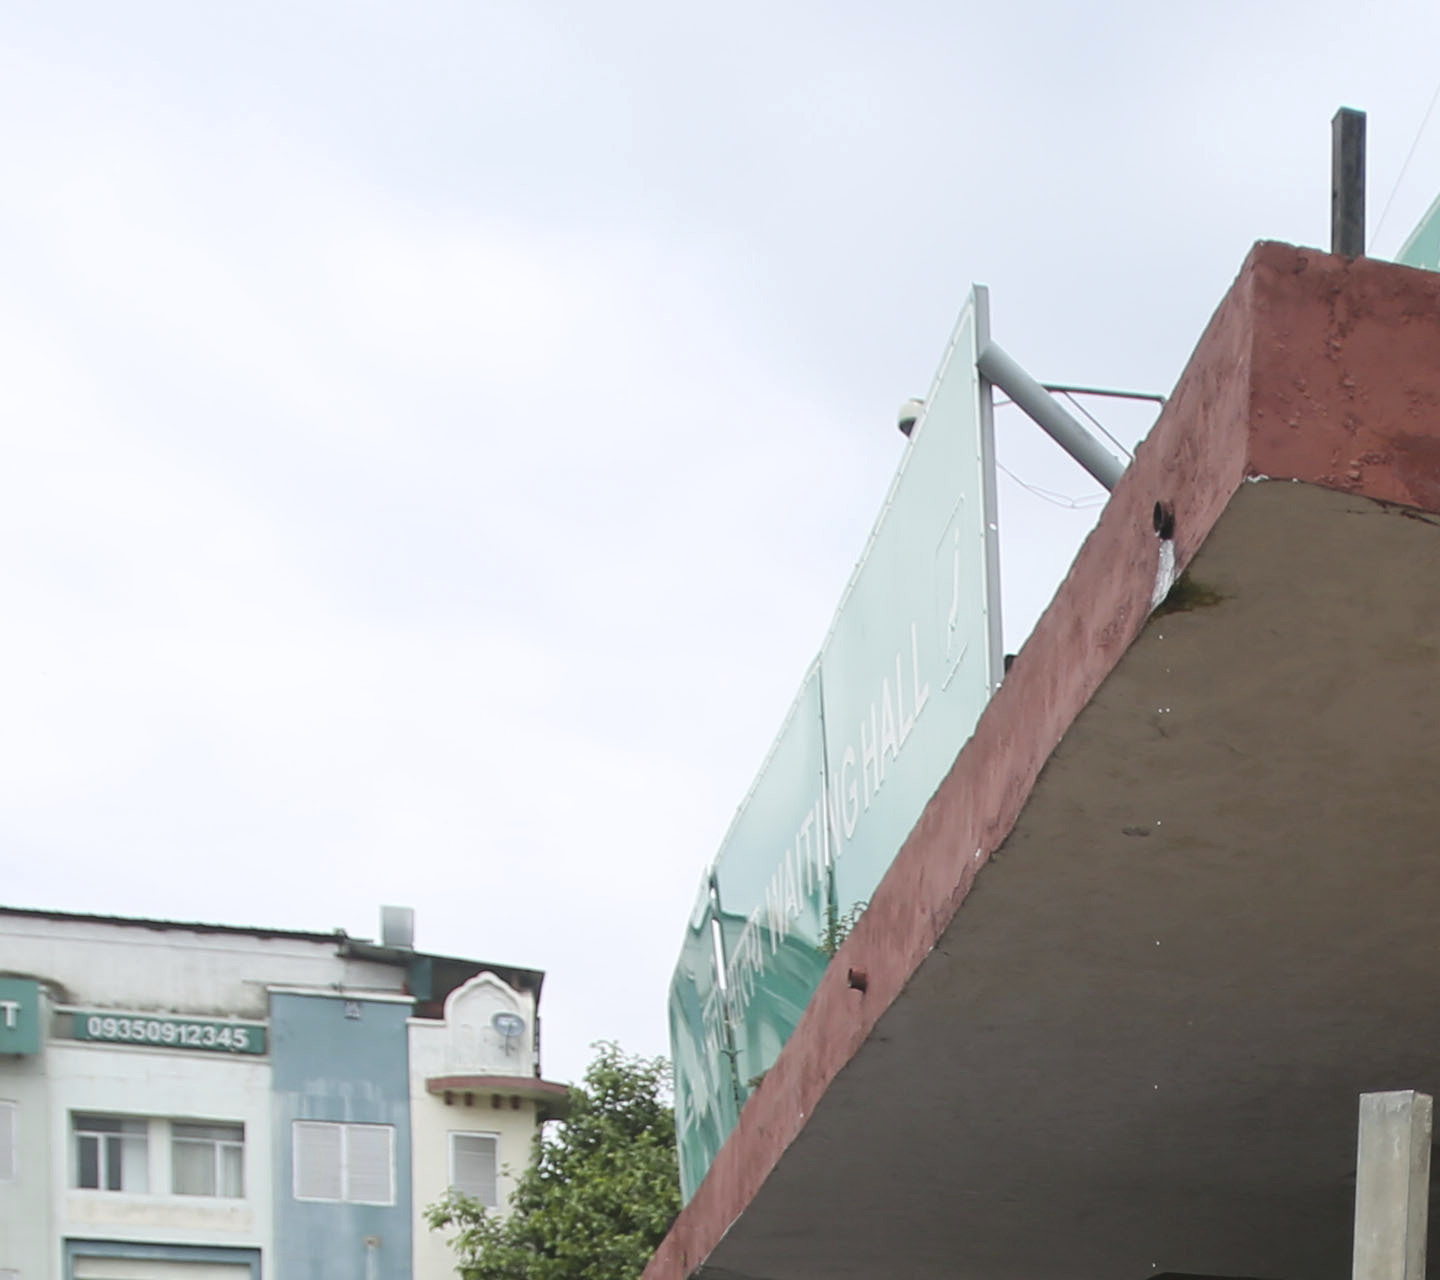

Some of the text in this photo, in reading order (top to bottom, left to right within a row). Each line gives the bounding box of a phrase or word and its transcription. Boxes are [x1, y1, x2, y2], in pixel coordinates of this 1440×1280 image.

[766, 621, 929, 957] WAITING HALL
[87, 1015, 249, 1049] 09350912345
